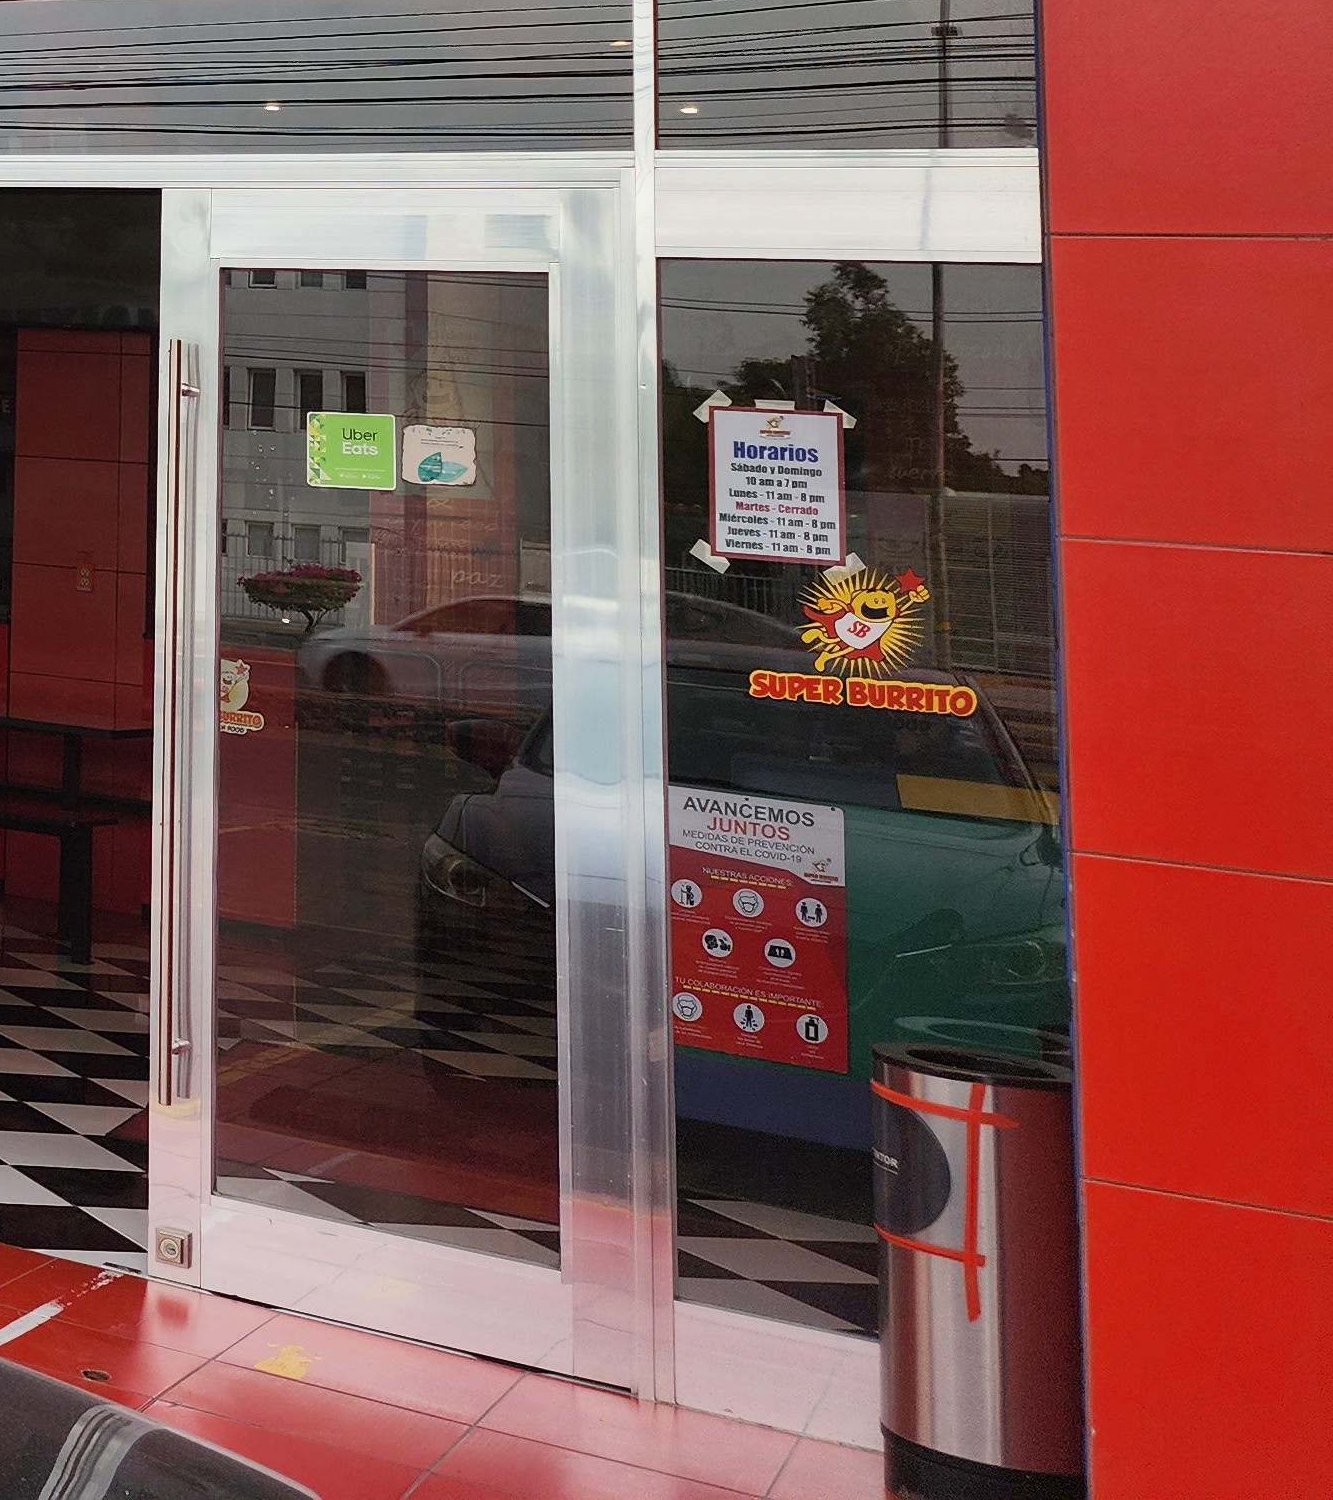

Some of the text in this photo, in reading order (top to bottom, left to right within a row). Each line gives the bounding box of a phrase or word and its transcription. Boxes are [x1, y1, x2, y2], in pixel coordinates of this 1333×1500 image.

[342, 428, 378, 441] Uber
[342, 441, 378, 456] Eats
[733, 441, 819, 463] Horarios
[730, 462, 767, 474] Sábado
[778, 465, 822, 478] Domingo
[746, 476, 756, 486] 10
[758, 478, 774, 487] am
[791, 480, 808, 489] pm
[728, 488, 758, 499] Lunes
[765, 490, 775, 500] 11
[777, 492, 792, 501] am
[800, 493, 807, 502] 8
[809, 494, 825, 504] pm
[735, 501, 770, 512] Martes
[778, 503, 819, 516] Cerrado
[719, 513, 769, 525] Miércoles
[776, 517, 786, 526] 11
[788, 518, 803, 528] am
[811, 519, 818, 528] 8
[820, 521, 836, 530] pm
[727, 526, 761, 537] Jueves
[769, 529, 779, 539] 11
[780, 530, 796, 540] am
[803, 531, 810, 541] 8
[812, 533, 829, 542] pm
[725, 538, 764, 550] Viernes
[771, 542, 781, 552] 11
[782, 543, 799, 553] am
[806, 544, 813, 554] 8
[815, 546, 831, 556] pm
[847, 620, 871, 639] SB
[751, 672, 975, 715] SUPER BURRITO
[683, 796, 815, 827] AVANCEMOS
[707, 817, 790, 841] JUNTOS
[683, 829, 815, 855] MEDIDAS DE PREVENCIÓN
[695, 841, 802, 863] CONTRA EL COVID-19
[702, 867, 747, 880] NUESTRAS
[675, 976, 686, 985] TU
[688, 977, 753, 995] COLABORACIÓN
